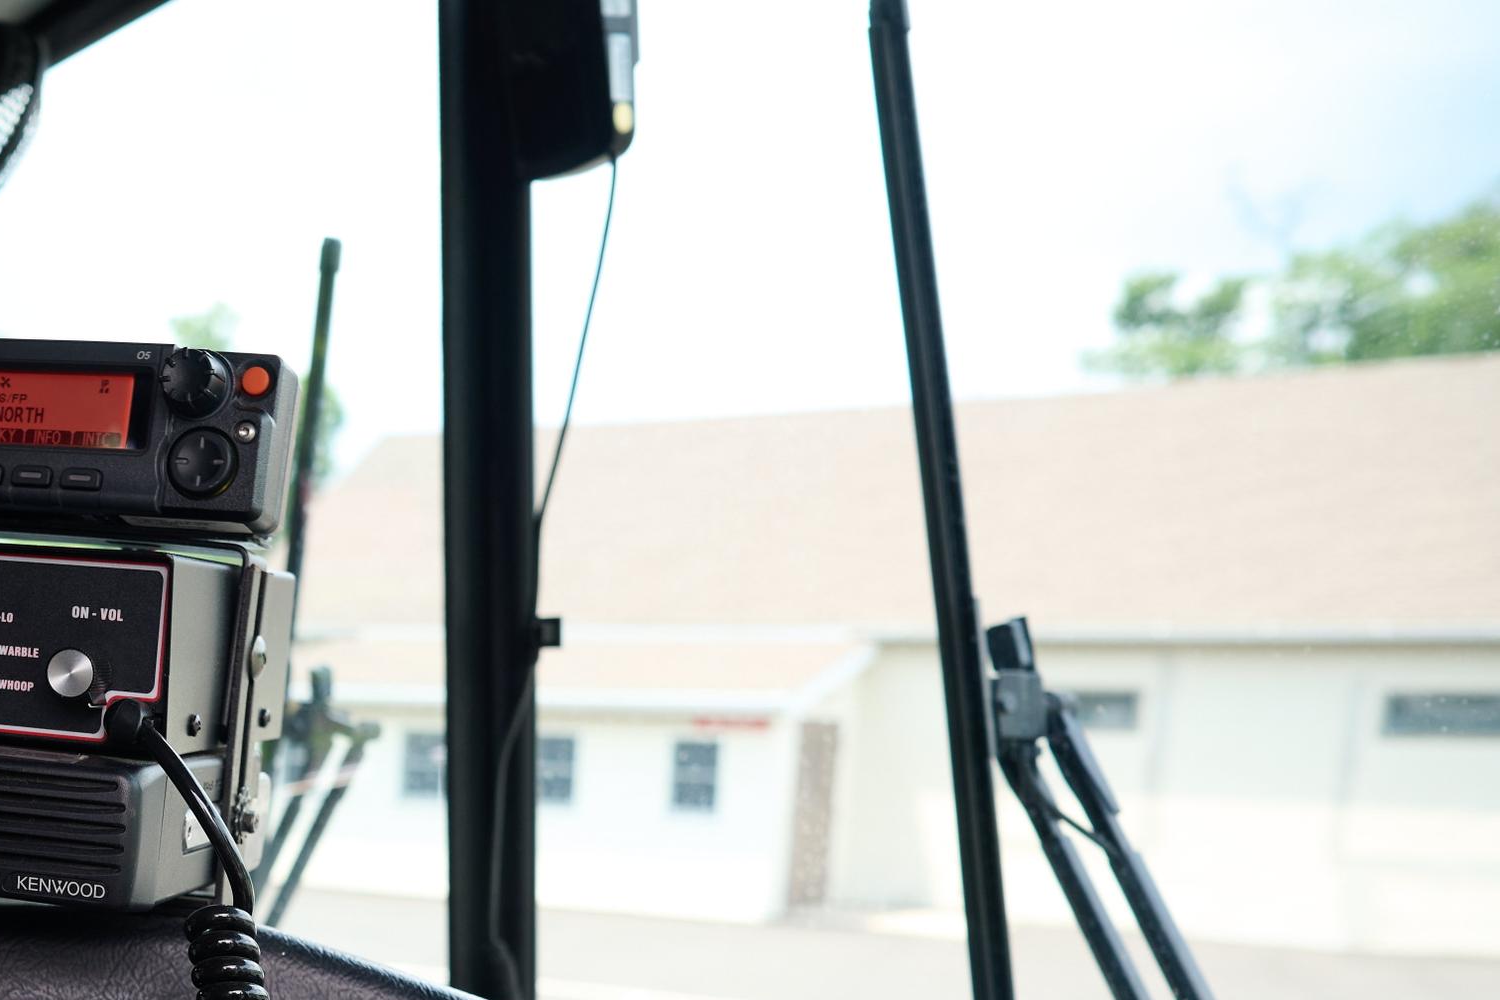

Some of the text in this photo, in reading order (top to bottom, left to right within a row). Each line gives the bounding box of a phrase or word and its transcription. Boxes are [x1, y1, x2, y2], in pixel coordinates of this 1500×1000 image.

[33, 430, 61, 446] INFO
[100, 607, 124, 622] VOL
[17, 875, 106, 899] KENWOOD
